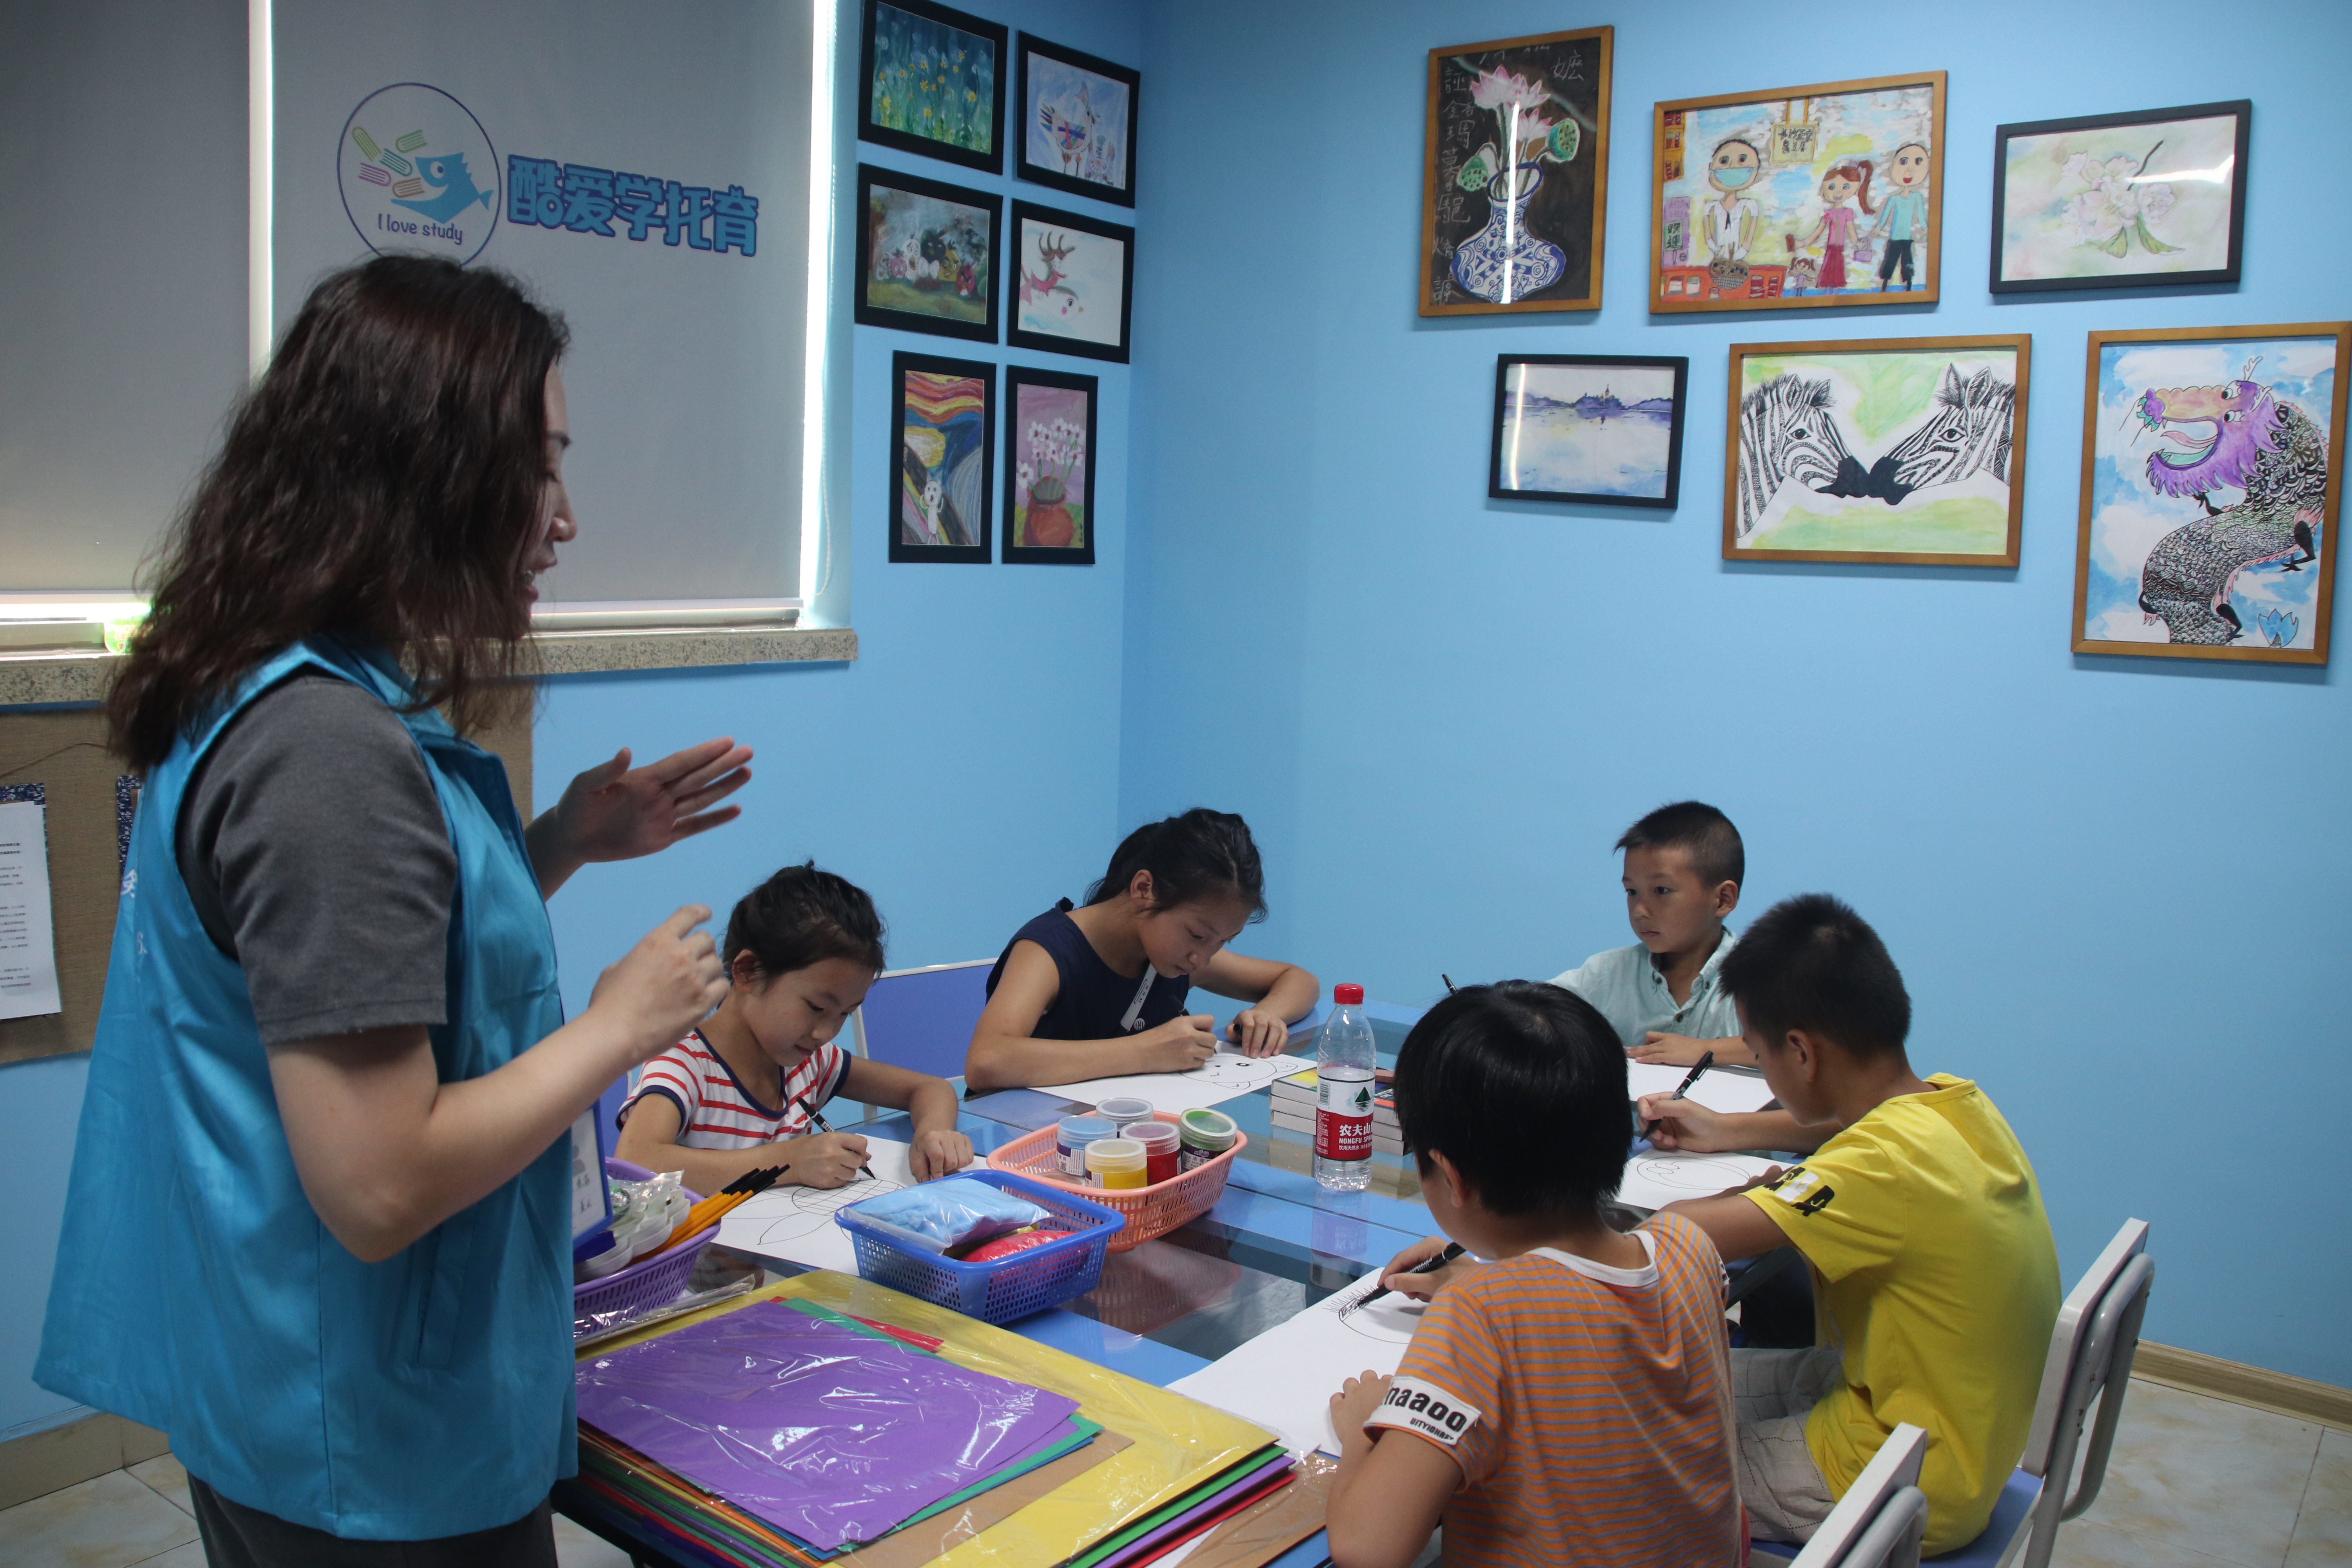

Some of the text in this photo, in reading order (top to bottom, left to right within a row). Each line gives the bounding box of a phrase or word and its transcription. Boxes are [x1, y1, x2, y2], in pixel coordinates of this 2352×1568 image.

[507, 153, 759, 257] 酷爱学托育
[378, 213, 463, 245] I love study
[1382, 1387, 1467, 1432] naaoo
